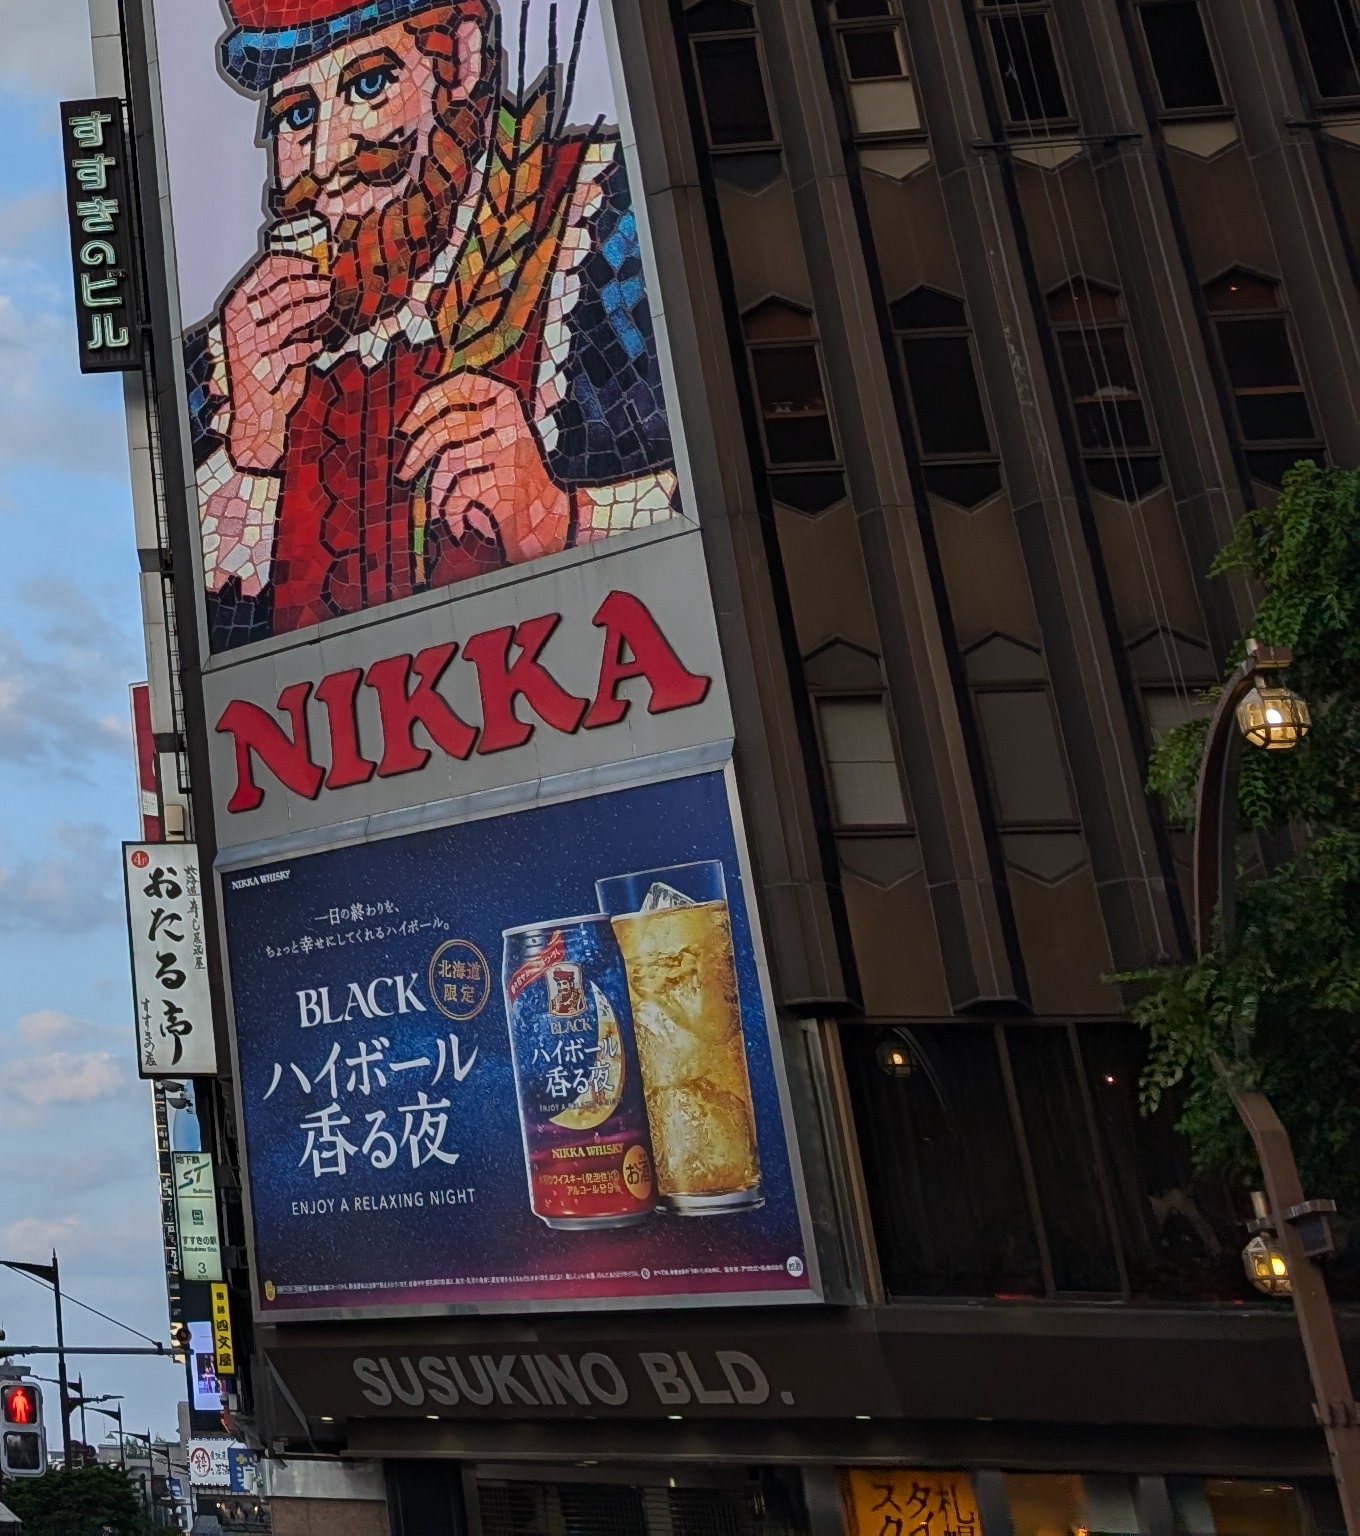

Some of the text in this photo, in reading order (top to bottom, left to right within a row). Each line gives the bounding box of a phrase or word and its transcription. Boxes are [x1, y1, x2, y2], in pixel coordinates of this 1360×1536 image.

[69, 111, 129, 350] すすきのビル
[216, 590, 711, 814] NIKKA
[133, 852, 148, 865] 4F
[232, 870, 291, 890] NIKKA WHISKY
[315, 901, 400, 924] 一日の終わりを、
[265, 918, 450, 958] ちょっと幸せにしてくれるハイボール。
[143, 866, 193, 1066] おたる亭
[438, 960, 481, 982] 北海道
[296, 972, 427, 1028] BLACK
[443, 983, 475, 1004] 限定
[551, 1018, 592, 1035] BLACK
[531, 1037, 618, 1065] ハイボール
[263, 1034, 478, 1101] ハイボール
[545, 1063, 614, 1098] 香る夜
[298, 1092, 459, 1179] 香る夜
[552, 1144, 625, 1158] NIKKA WHISKY
[626, 1158, 652, 1185] お酒
[291, 1188, 476, 1216] ENJOY A RELAXING NIGHT
[182, 1236, 217, 1246] すすきの駅
[198, 1262, 206, 1275] 3
[352, 1350, 795, 1407] SUSUKINO BLD.
